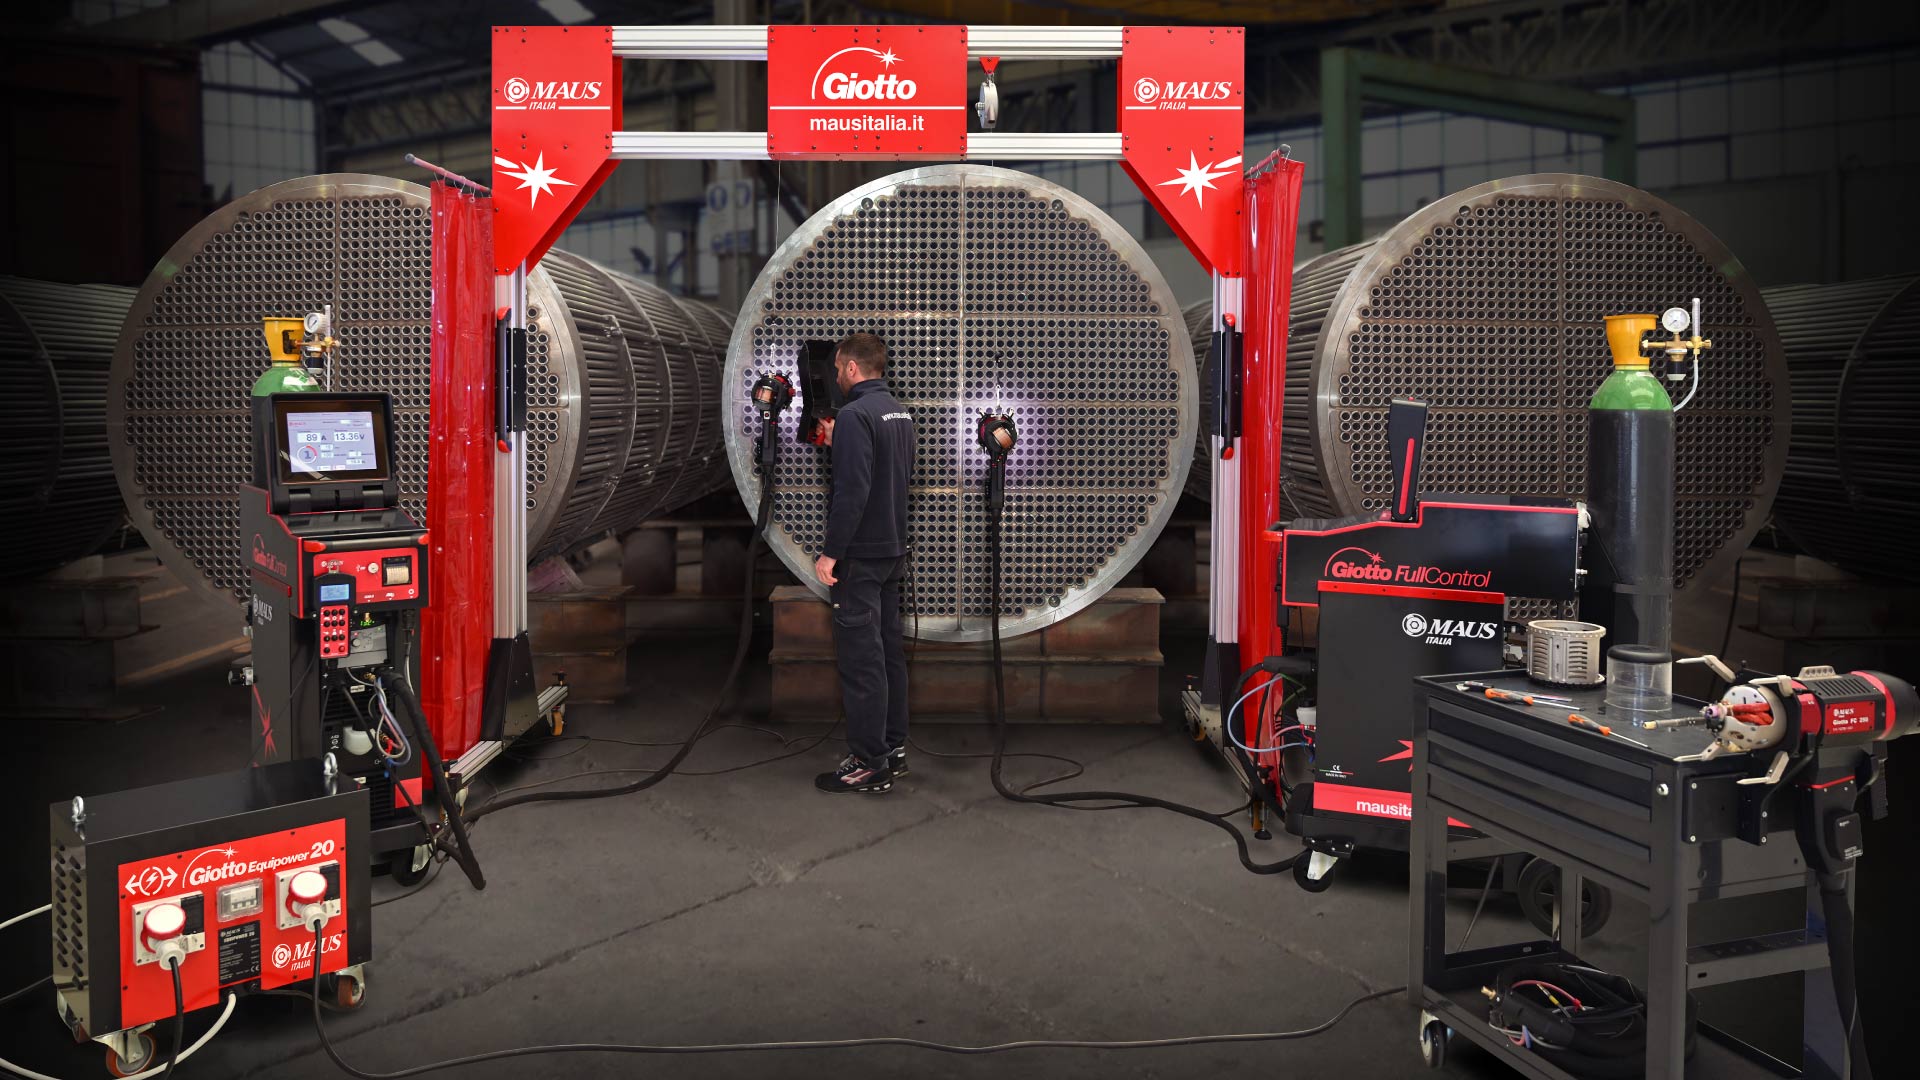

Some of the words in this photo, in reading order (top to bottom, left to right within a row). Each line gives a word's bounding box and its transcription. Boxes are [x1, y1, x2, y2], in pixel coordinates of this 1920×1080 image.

[530, 81, 602, 100] MAUS
[822, 72, 917, 100] Giotto
[1160, 81, 1232, 100] MAUS
[529, 102, 556, 110] ITALIA
[1159, 102, 1186, 110] ITALIA
[810, 114, 924, 131] mausitalia.it
[306, 433, 318, 442] 89
[1331, 561, 1393, 581] Giotto
[1394, 564, 1492, 588] FullControl
[1427, 618, 1498, 640] MAUS
[1425, 636, 1453, 646] ITALIA
[189, 860, 247, 886] Giotto
[248, 852, 310, 874] Equipower
[310, 839, 335, 859] 20
[291, 960, 311, 971] ITALIA
